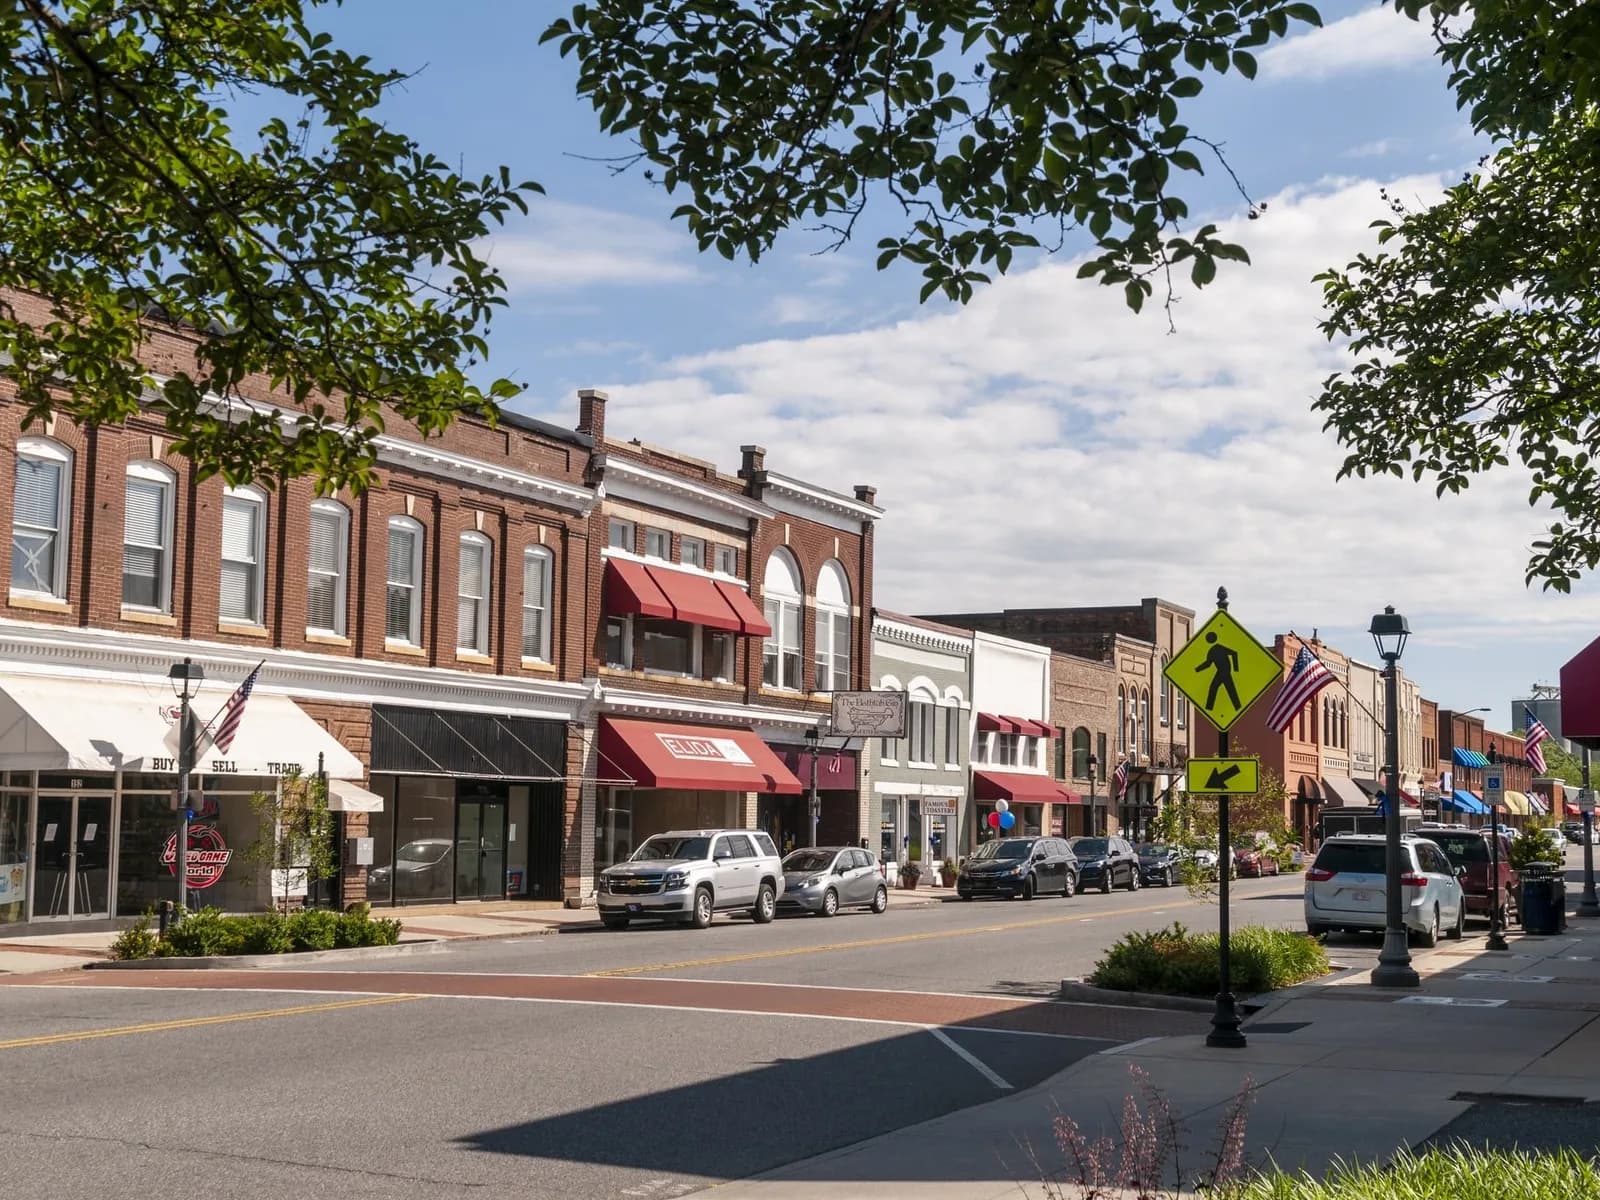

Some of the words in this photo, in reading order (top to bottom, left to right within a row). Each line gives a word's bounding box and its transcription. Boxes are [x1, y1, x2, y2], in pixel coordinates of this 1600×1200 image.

[665, 739, 722, 757] ELIDA
[152, 757, 175, 771] BUY
[212, 760, 238, 773] SELL
[200, 852, 228, 861] GAME
[187, 867, 214, 875] orld
